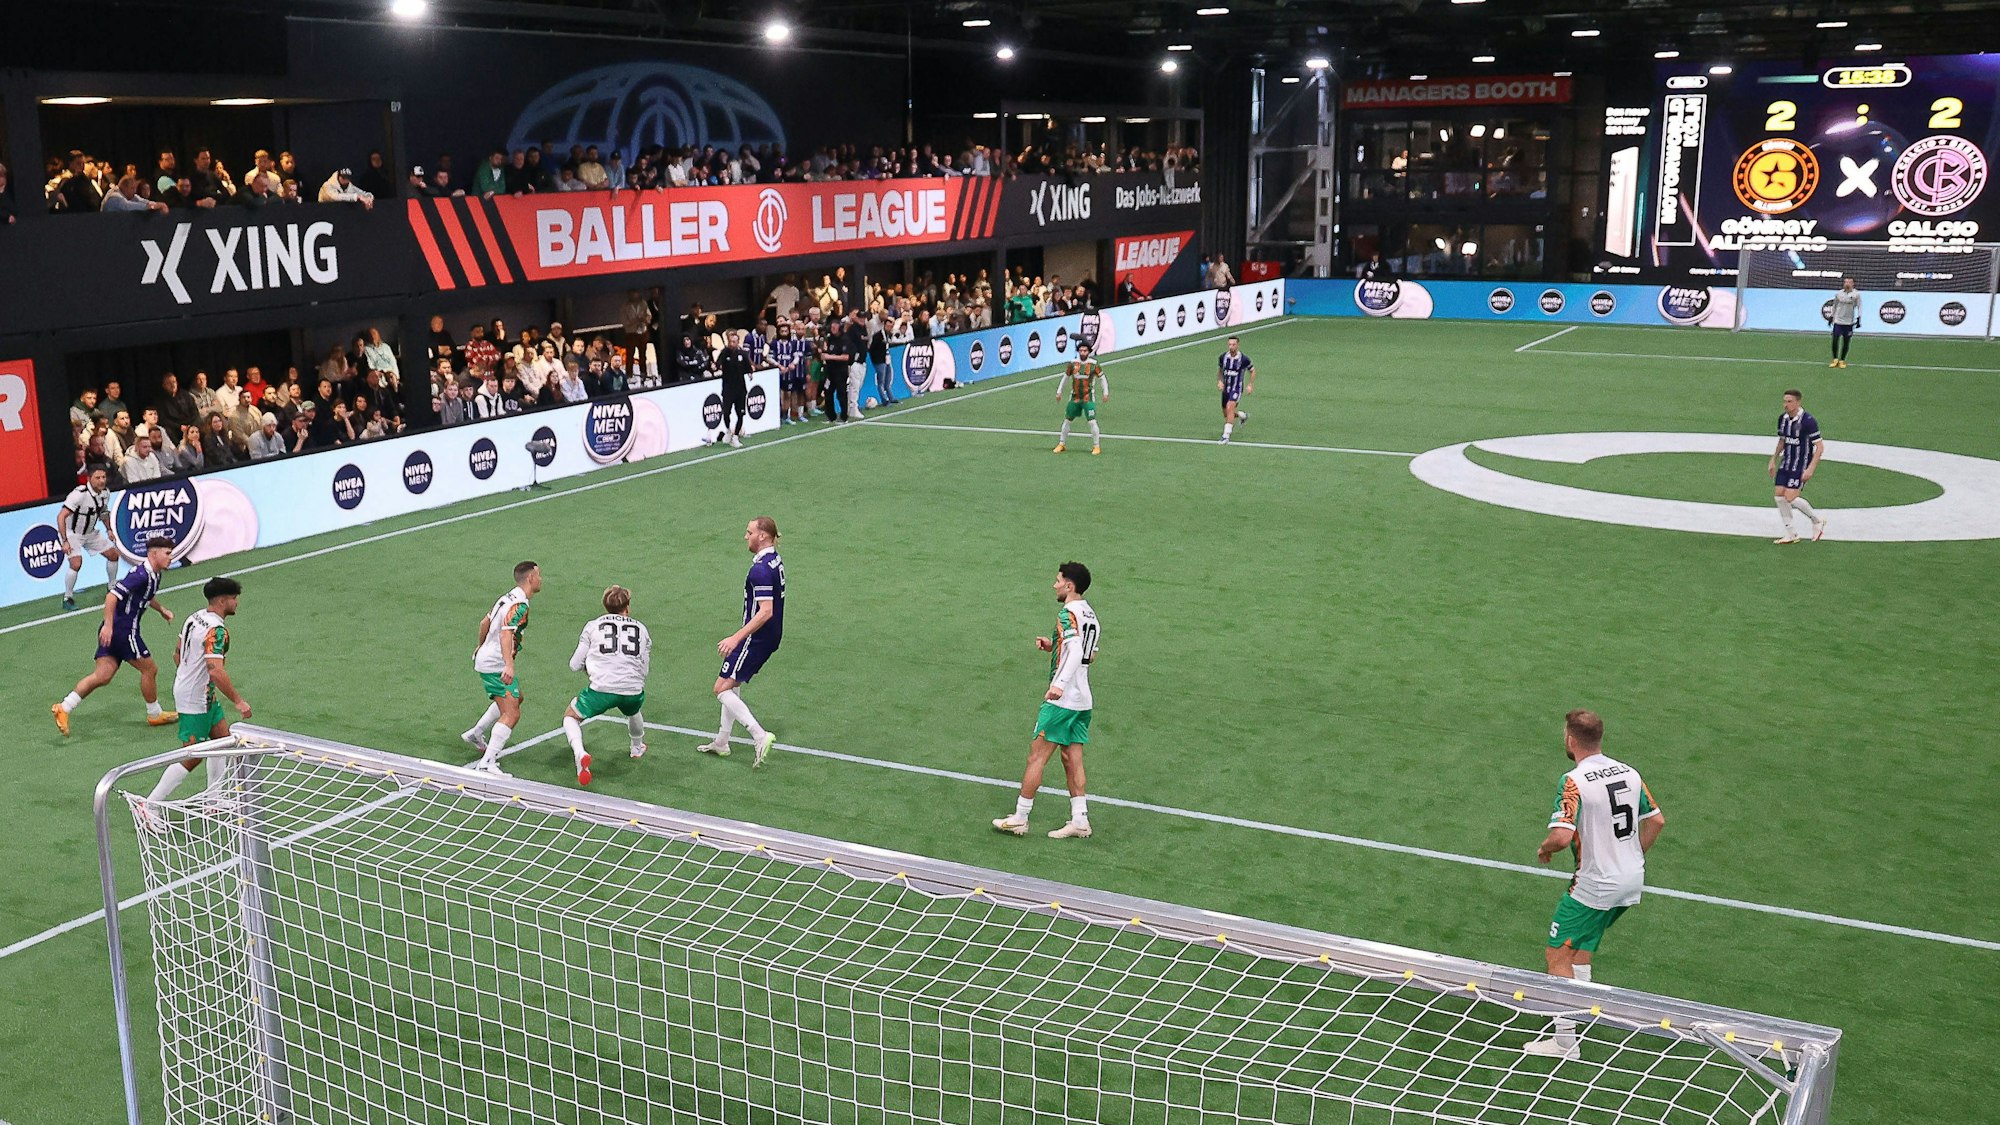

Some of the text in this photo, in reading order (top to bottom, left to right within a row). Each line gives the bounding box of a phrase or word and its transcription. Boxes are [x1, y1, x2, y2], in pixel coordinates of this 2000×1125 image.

[1347, 81, 1557, 103] MANAGERS BOOTH
[1765, 100, 1797, 131] 2
[1928, 97, 1963, 129] 2
[1049, 182, 1091, 222] XING
[1115, 186, 1135, 209] Das
[536, 189, 946, 268] BALLER LEAGUE
[1720, 216, 1817, 236] GÖNRGY
[1887, 220, 1979, 237] CALCIO
[205, 221, 340, 294] XING
[1116, 236, 1181, 271] LEAGUE
[1363, 281, 1398, 293] NIVEA
[1364, 288, 1394, 301] MEN
[1668, 287, 1707, 300] NIVEA
[1668, 296, 1703, 309] MEN
[909, 344, 933, 358] NIVEA
[910, 356, 931, 369] MEN
[748, 394, 766, 406] NIVEA
[750, 403, 763, 413] MEN
[592, 403, 630, 420] NIVEA
[703, 403, 722, 416] NIVEA
[705, 412, 721, 422] MEN
[593, 418, 626, 434] MEN
[471, 449, 497, 464] NIVEA
[404, 462, 432, 478] NIVEA
[474, 460, 493, 472] MEN
[334, 476, 364, 493] NIVEA
[408, 473, 429, 486] MEN
[128, 487, 192, 511] NIVEA
[339, 488, 360, 501] MEN
[130, 507, 184, 530] MEN
[23, 539, 62, 558] NIVEA
[29, 553, 58, 570] MEN
[598, 621, 640, 657] 33
[1081, 622, 1097, 665] 10
[721, 660, 731, 674] 9
[1606, 779, 1636, 842] 5
[1550, 922, 1560, 938] 5
